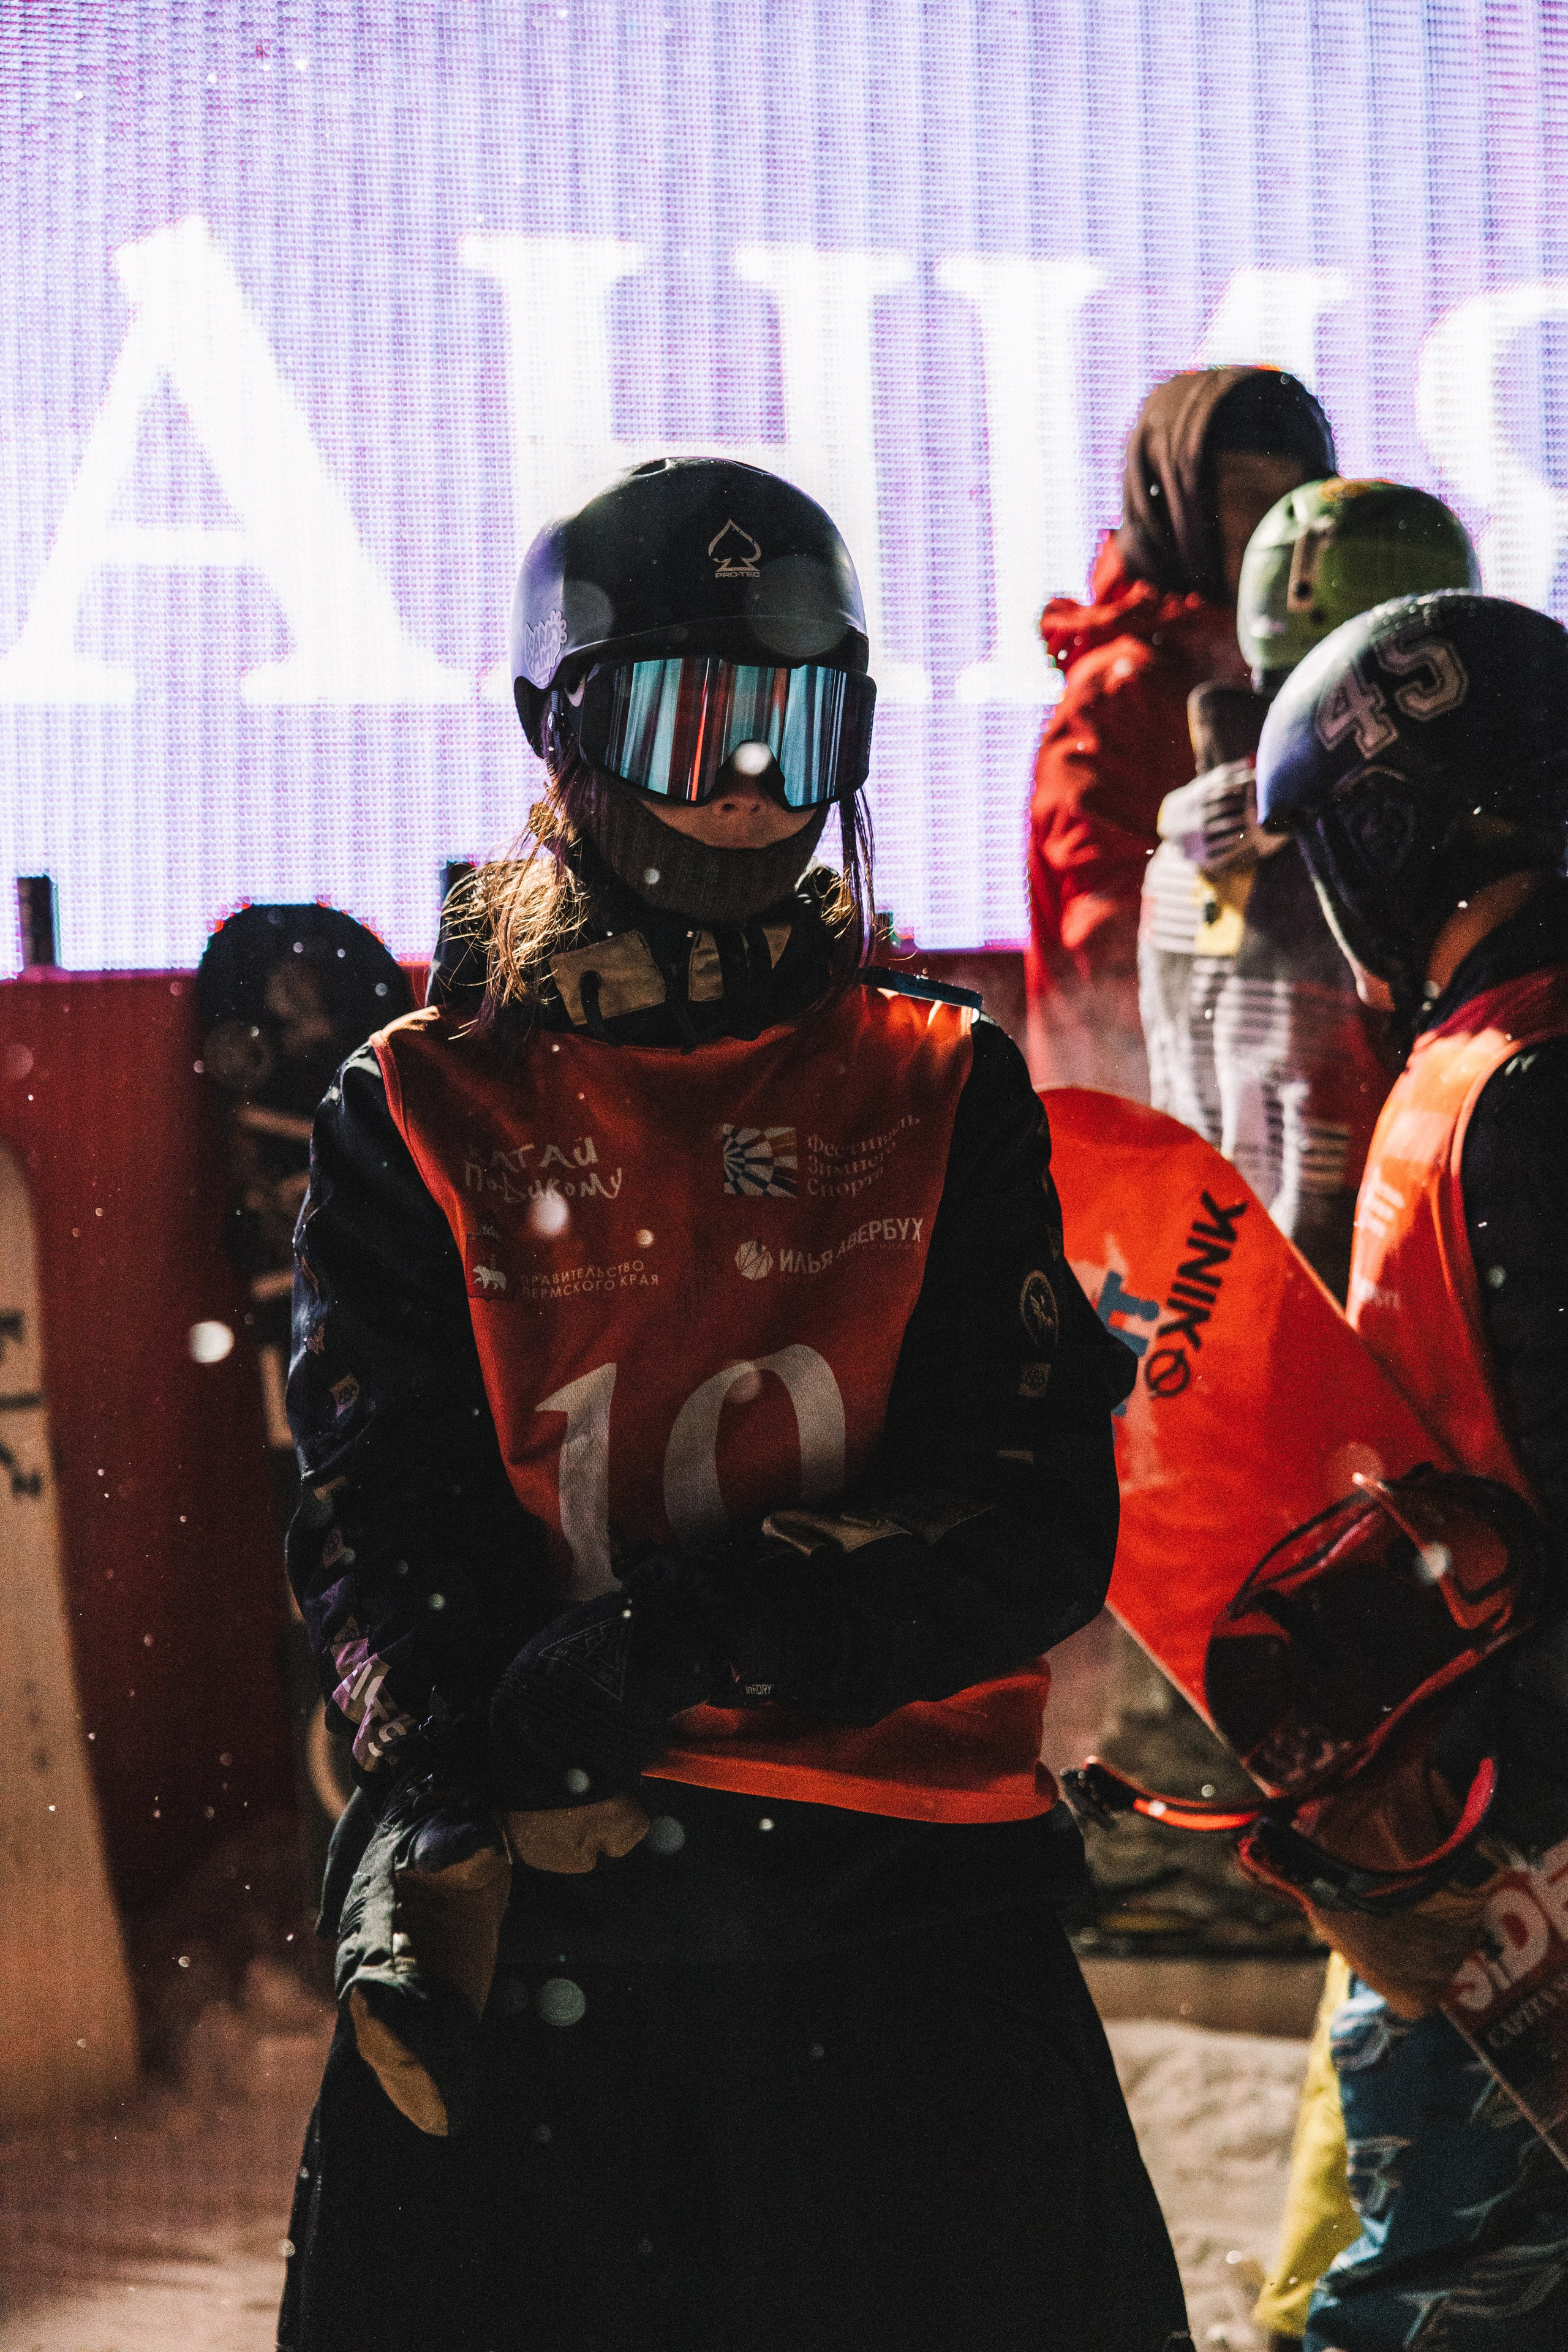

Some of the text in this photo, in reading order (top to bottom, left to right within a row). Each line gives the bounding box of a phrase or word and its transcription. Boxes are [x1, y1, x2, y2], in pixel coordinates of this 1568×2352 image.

[1315, 636, 1469, 760] 45
[521, 1259, 644, 1286] ПРАВИТЕЛЬСТВО
[779, 1217, 923, 1274] ИЛЬЯ АВЕРБУХ
[522, 1274, 659, 1298] ПЕРМСКОГО КРАЯ
[535, 1344, 846, 1602] 10
